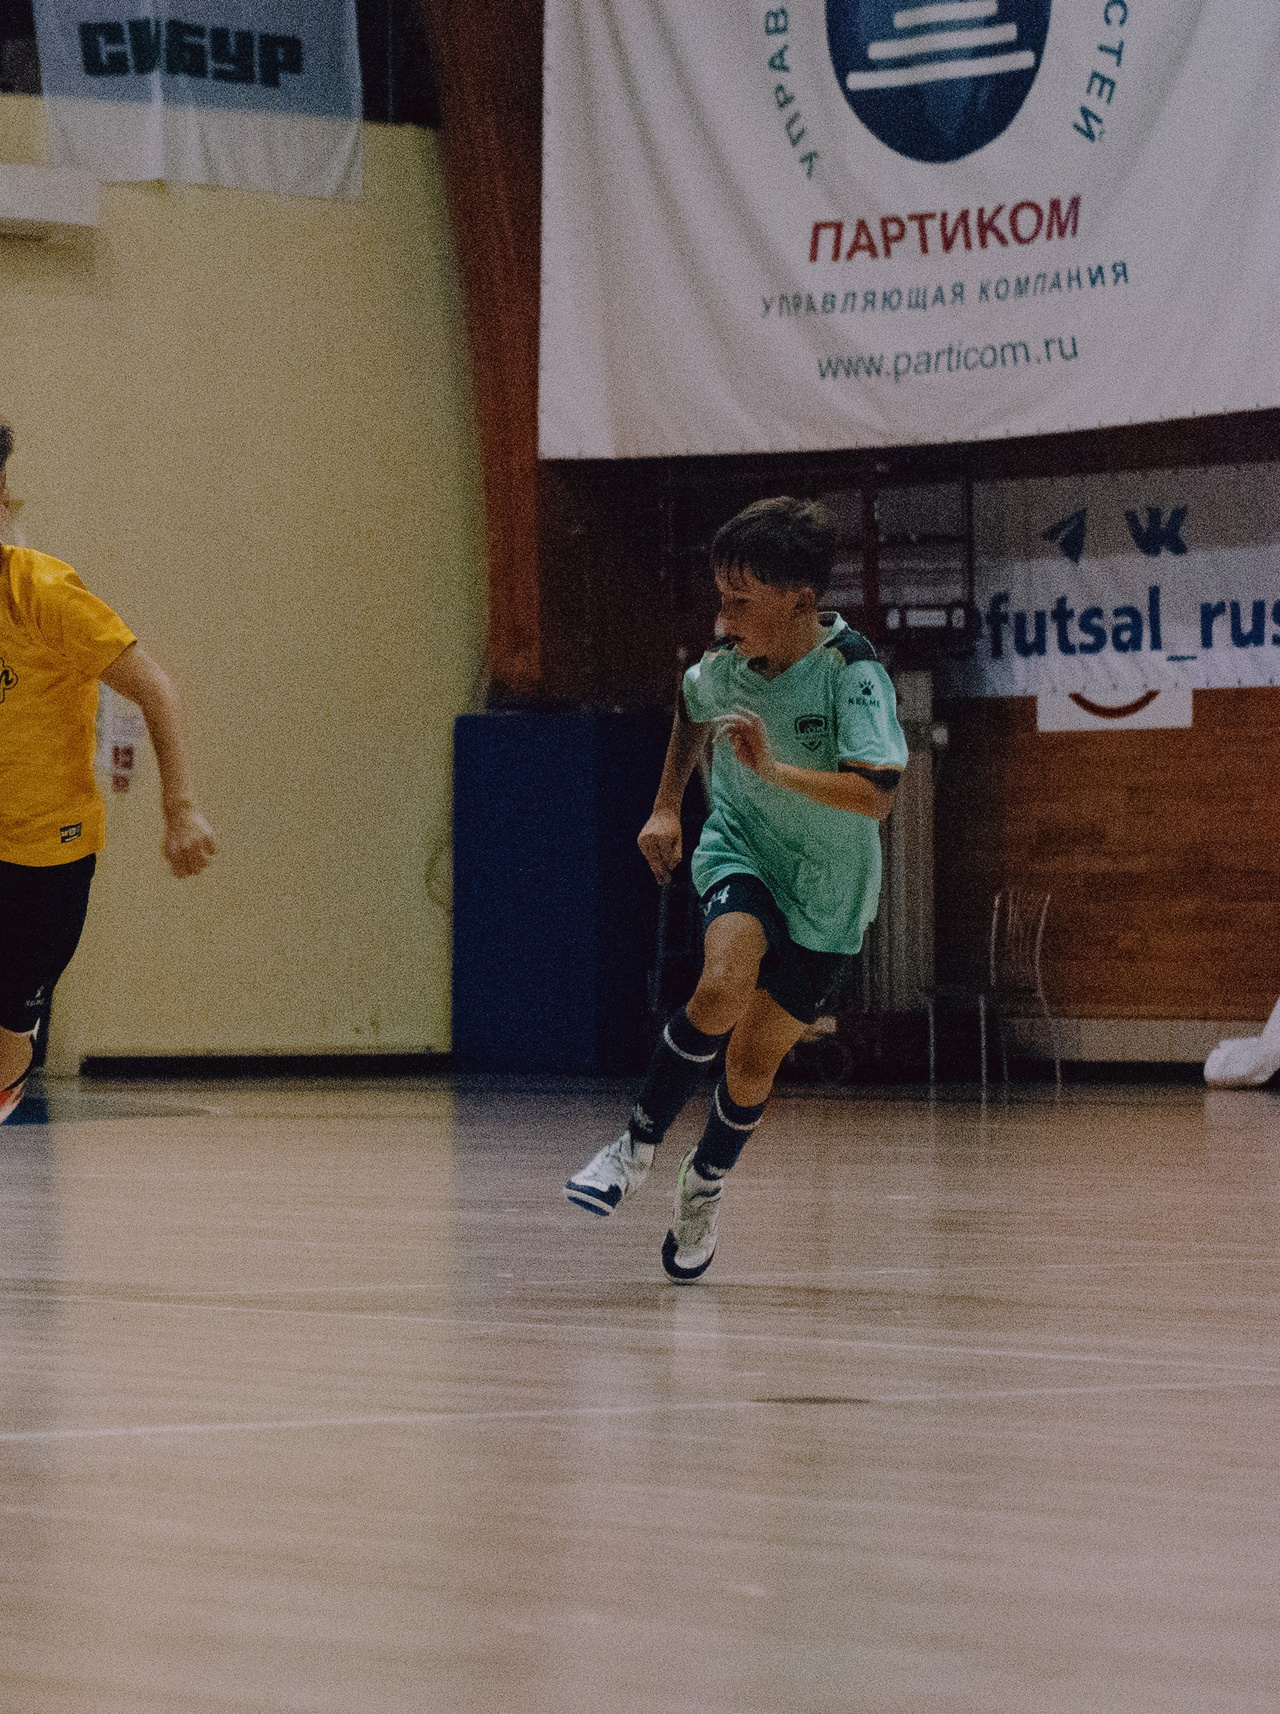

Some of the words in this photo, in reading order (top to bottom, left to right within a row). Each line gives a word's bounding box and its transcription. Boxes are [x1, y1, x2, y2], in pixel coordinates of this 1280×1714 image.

[808, 194, 1082, 264] ПАРТИКОМ
[761, 280, 966, 318] УПРАВЛЯЮЩАЯ
[977, 260, 1130, 304] КОМПАНИЯ
[817, 335, 1080, 384] www.particom.ru
